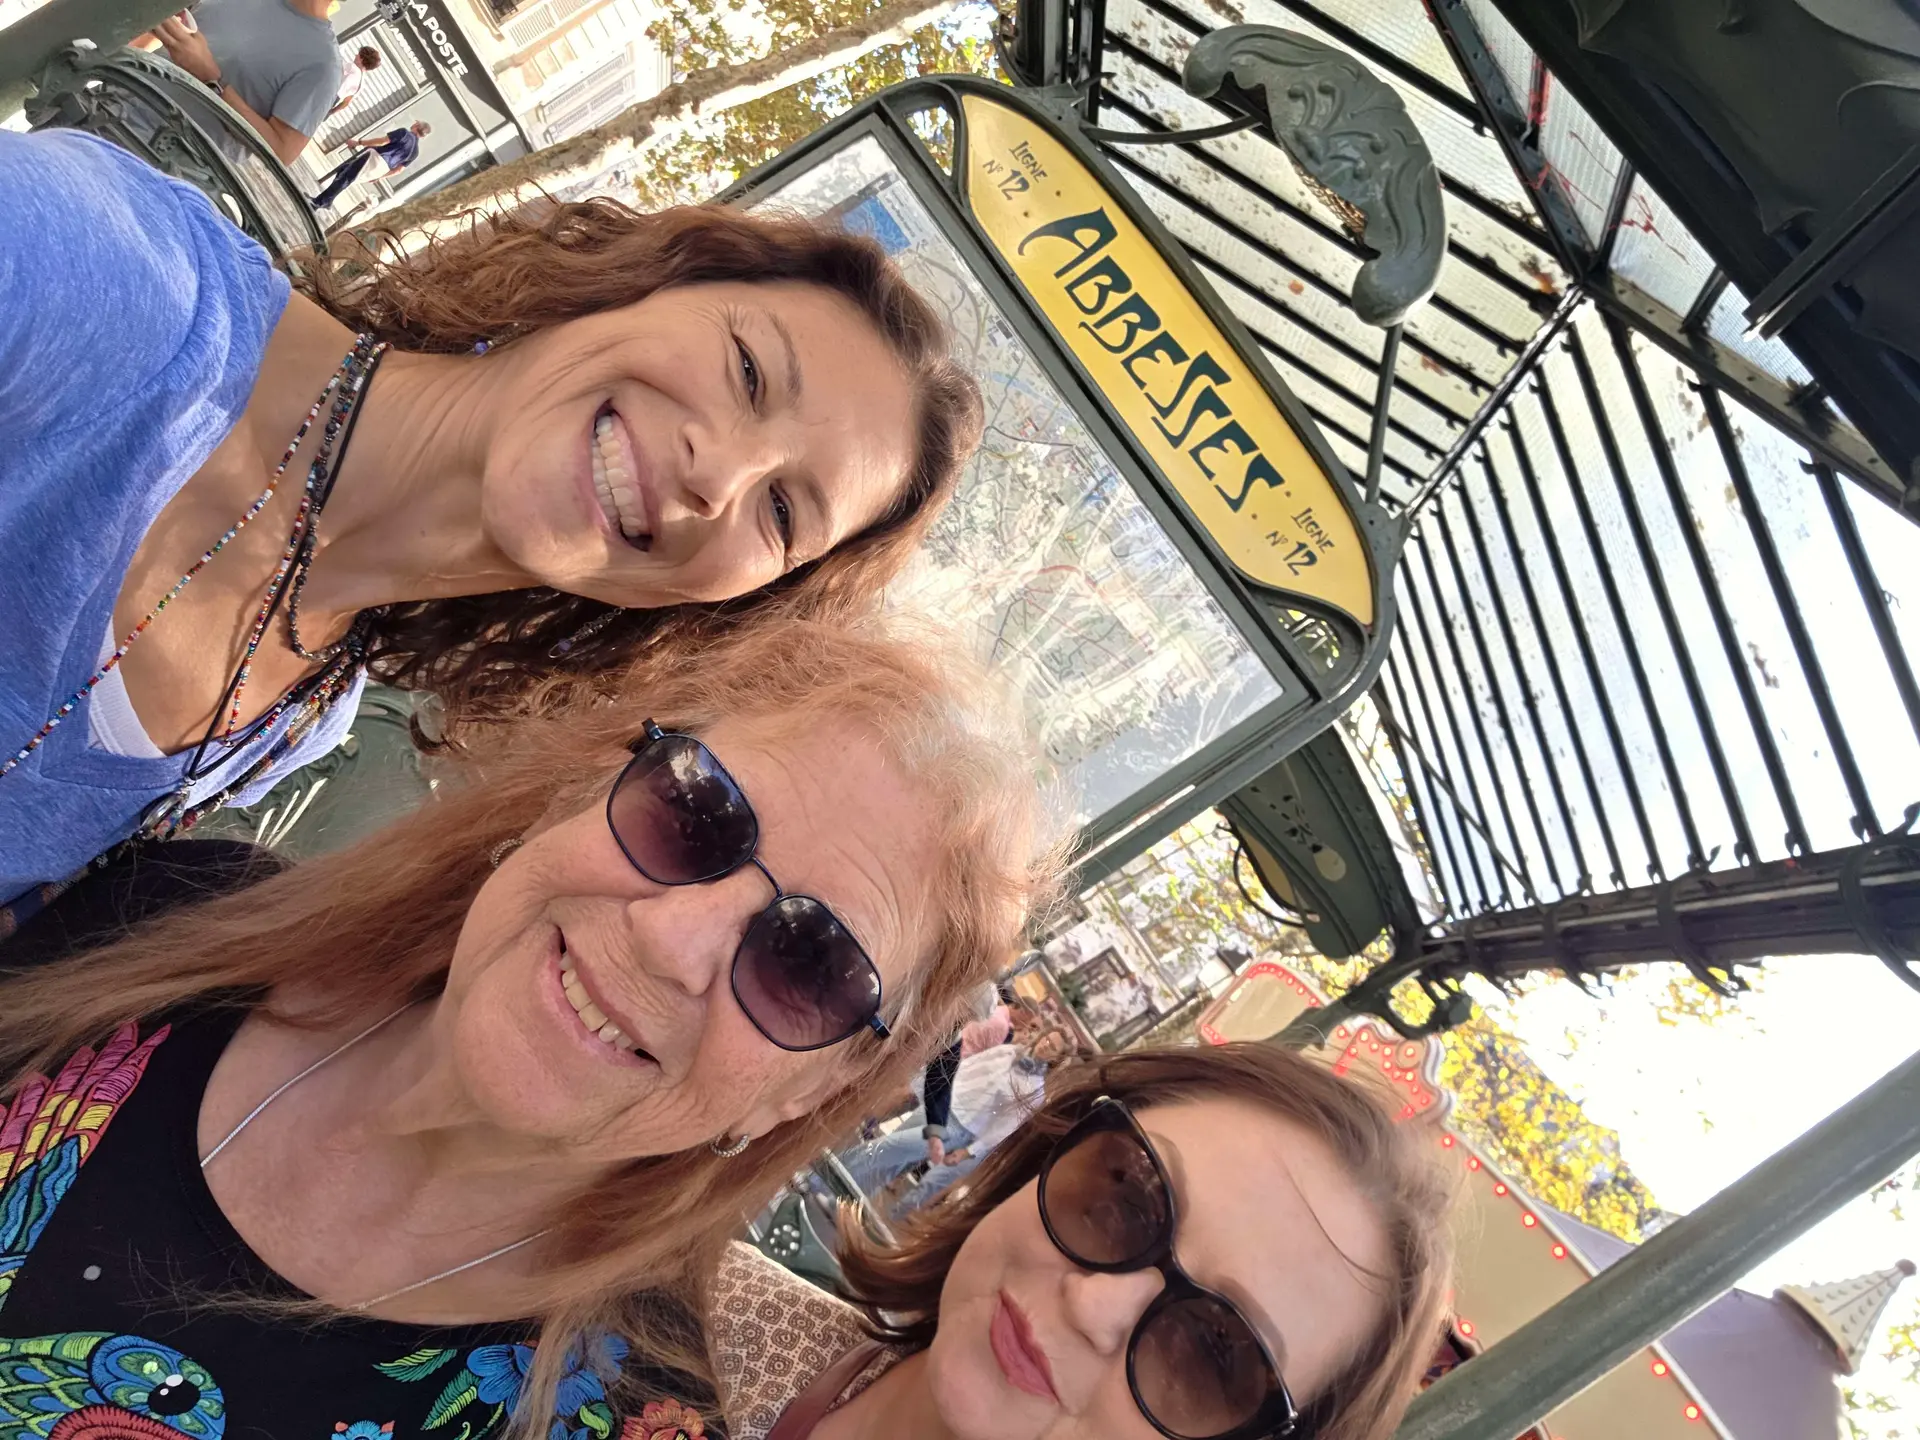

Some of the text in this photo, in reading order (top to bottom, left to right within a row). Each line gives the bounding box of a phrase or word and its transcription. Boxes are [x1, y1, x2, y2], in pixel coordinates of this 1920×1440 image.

[422, 16, 469, 80] POSTE
[997, 168, 1030, 201] 12
[1008, 140, 1048, 184] LIGNE
[1017, 206, 1286, 514] ABBESSES
[1290, 506, 1335, 555] LIGNE
[1282, 540, 1318, 576] 12
